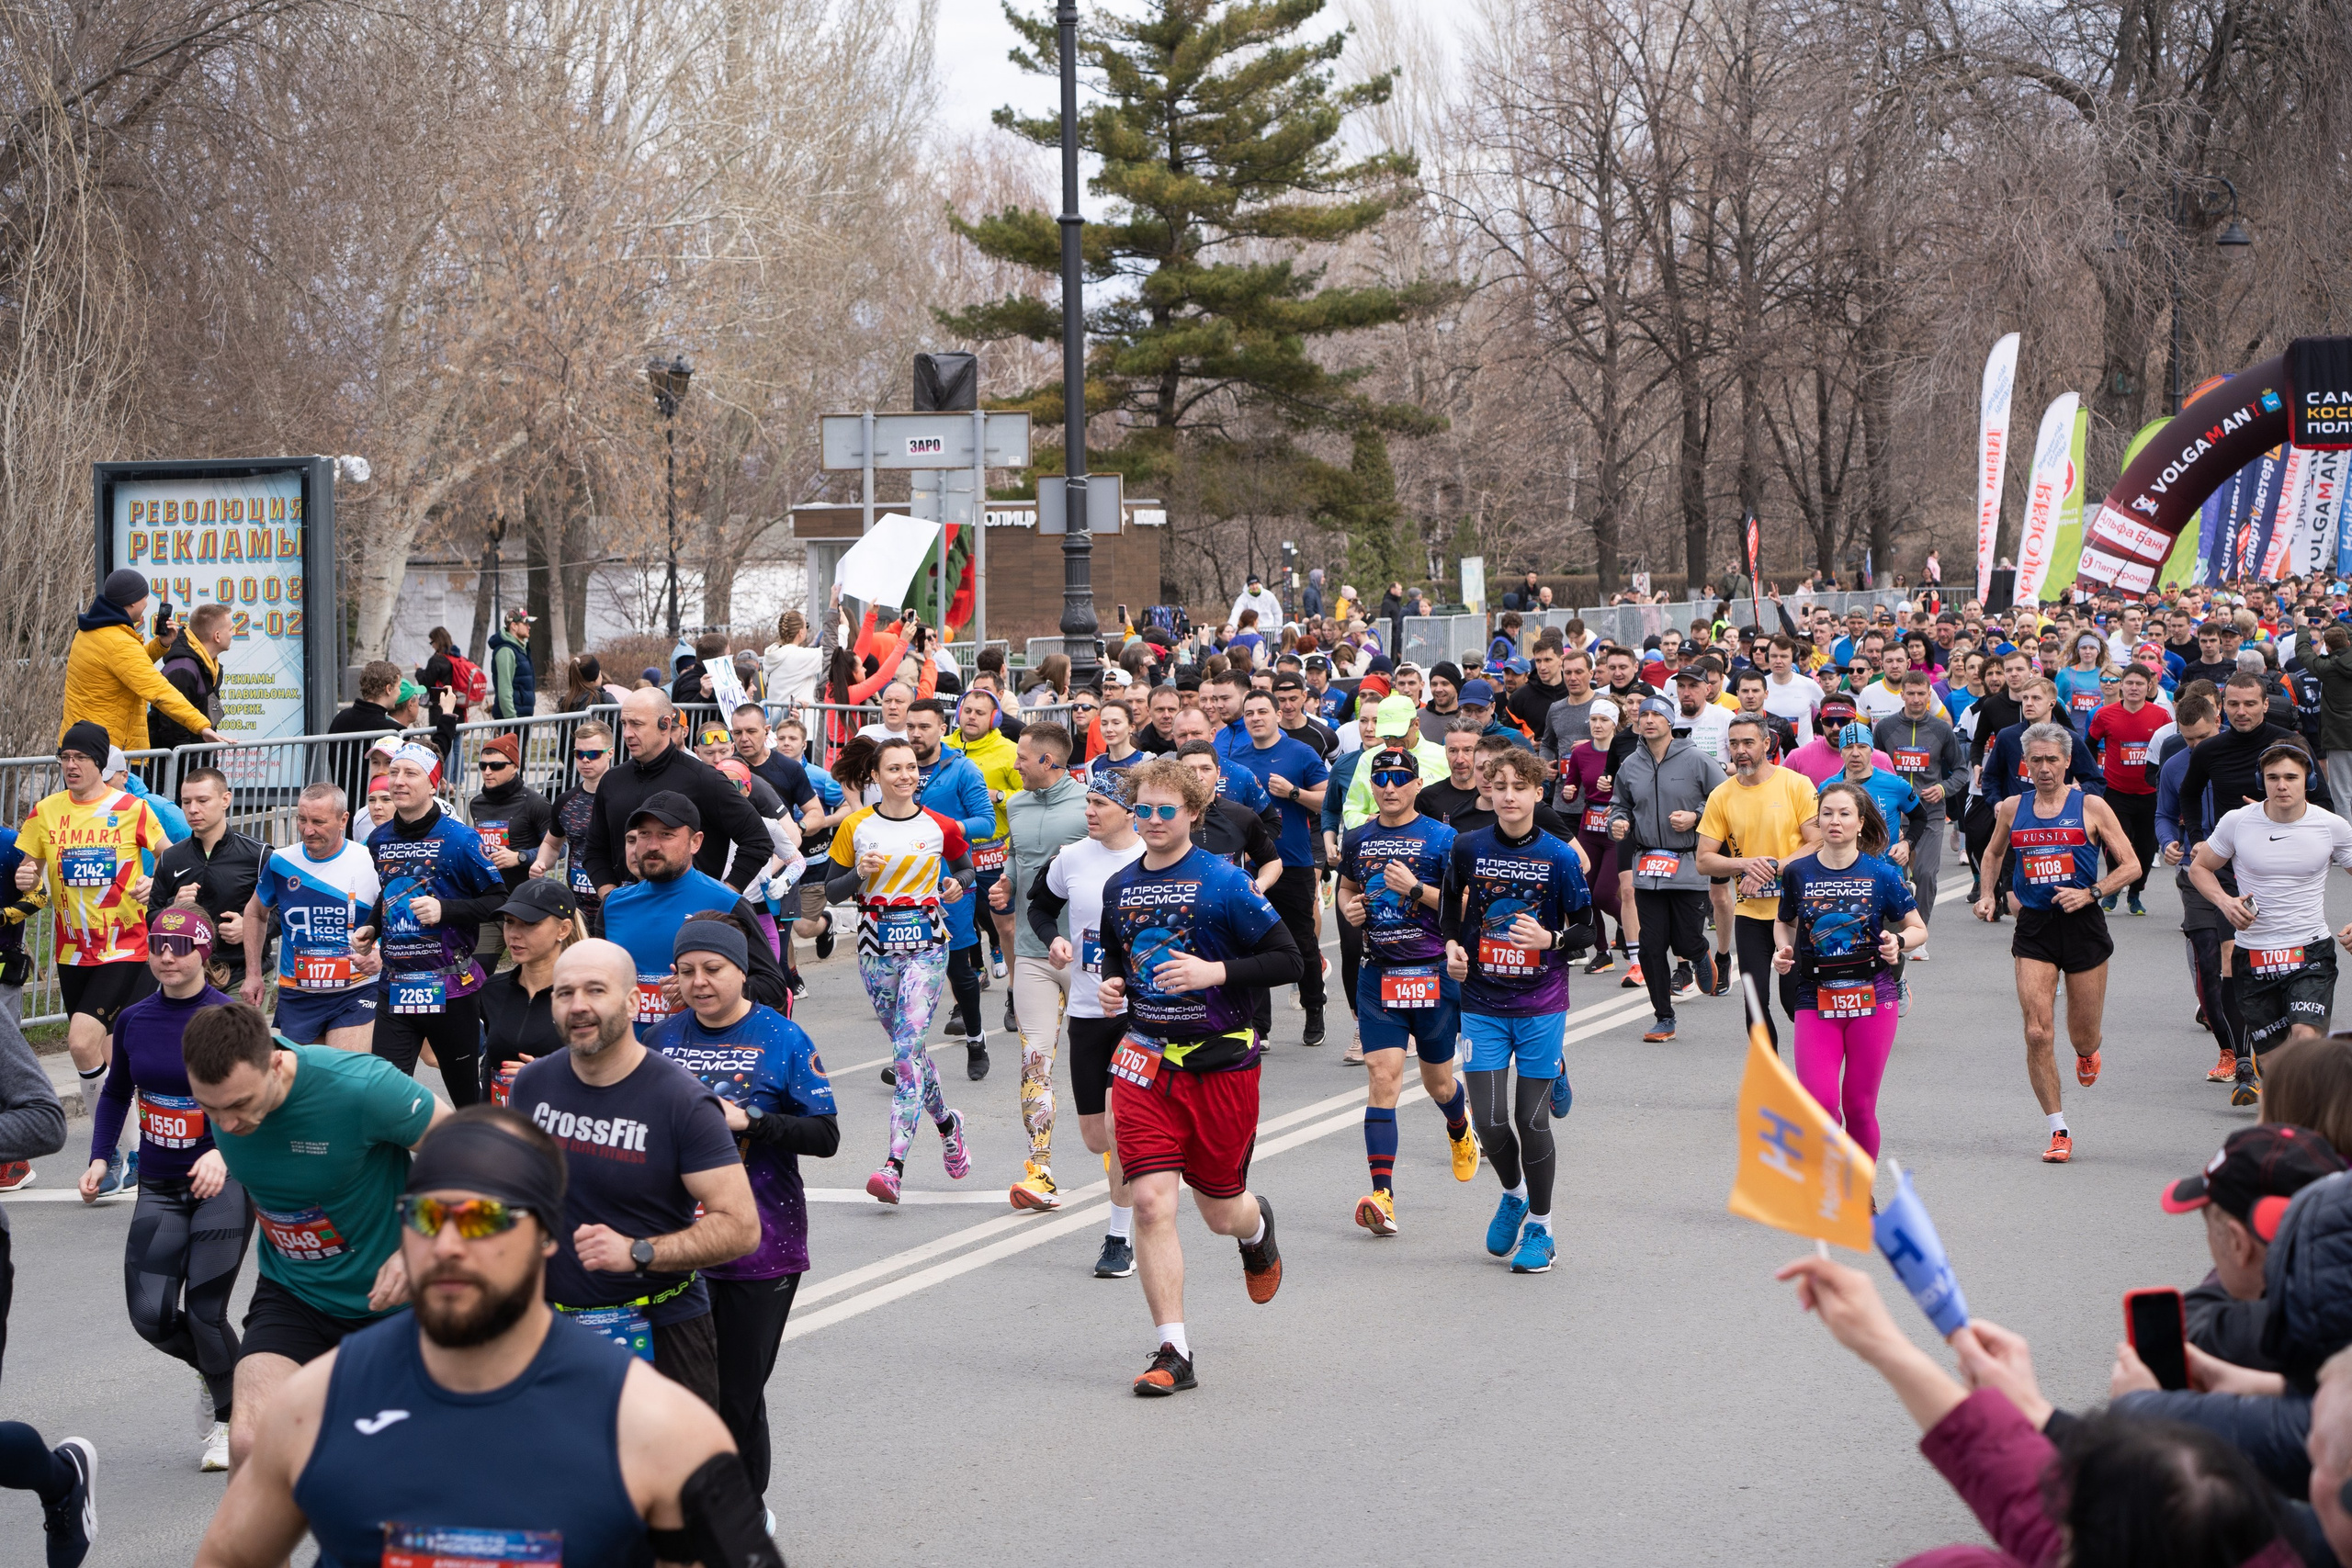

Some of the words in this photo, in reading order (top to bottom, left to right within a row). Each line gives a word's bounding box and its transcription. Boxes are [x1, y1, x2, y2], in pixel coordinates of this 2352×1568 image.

[2307, 407, 2352, 419] КОС
[2307, 421, 2352, 434] ПОЛ
[2150, 407, 2252, 493] VOLGAMAN
[129, 497, 302, 527] РЕВОЛЮЦИЯ
[2098, 512, 2133, 539] Альфа
[2134, 530, 2165, 552] Банк
[129, 527, 302, 565] РЕКЛАМЫ
[224, 673, 275, 685] РЕКЛАМЫ
[228, 687, 301, 699] ПАВИЛЬОНАХ,
[223, 704, 266, 716] ХОРЕКЕ.
[1901, 756, 1921, 765] 1783
[2129, 751, 2145, 760] 1172
[49, 829, 121, 844] SAMARA
[2023, 832, 2069, 842] RUSSIA
[808, 838, 830, 854] adid
[1359, 848, 1421, 856] КОСМОС
[379, 850, 440, 860] КОСМОС
[978, 852, 1003, 864] 1405
[74, 863, 105, 877] 2142
[1646, 860, 1668, 870] 1627
[2034, 860, 2062, 875] 1108
[1475, 866, 1550, 881] КОСМОС
[1804, 888, 1872, 897] КОСМОС
[1119, 893, 1196, 907] КОСМОС
[284, 907, 313, 942] Я
[312, 906, 346, 915] ПРО
[313, 917, 345, 925] СТО
[313, 926, 345, 934] КОС
[888, 926, 922, 942] 2020
[1492, 947, 1525, 964] 1766
[2261, 950, 2290, 964] 1707
[308, 964, 335, 978] 1177
[400, 988, 433, 1004] 2263
[1395, 984, 1426, 999] 1419
[1832, 993, 1861, 1010] 1521
[2251, 1016, 2290, 1042] MOTHER
[675, 1059, 756, 1071] ОСМОС
[1119, 1048, 1148, 1073] 1767
[149, 1113, 187, 1136] 1550
[532, 1101, 649, 1152] CrossFit
[271, 1229, 321, 1248] 1348
